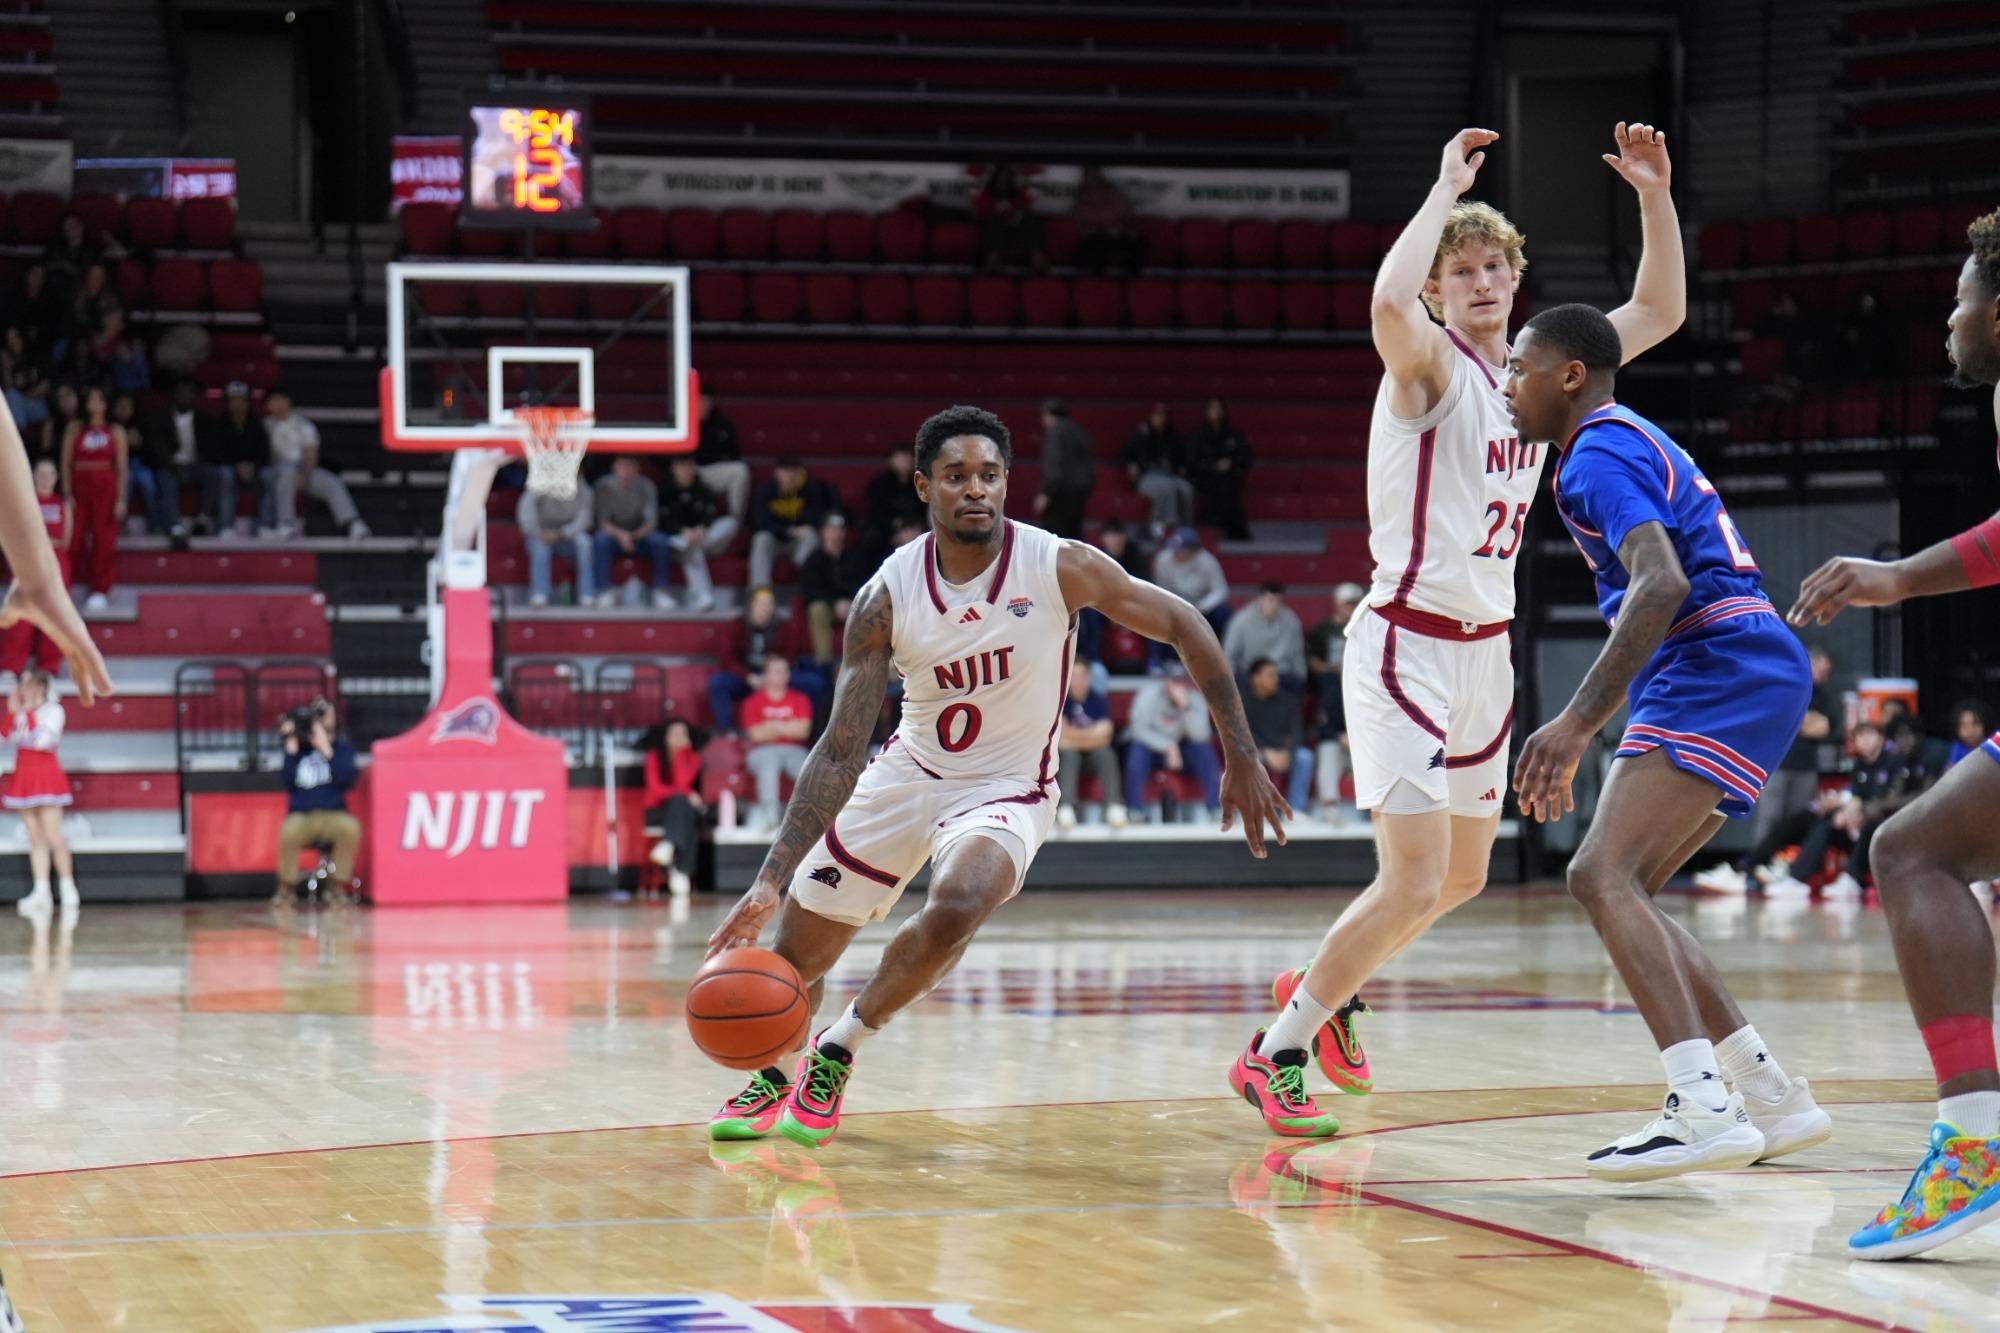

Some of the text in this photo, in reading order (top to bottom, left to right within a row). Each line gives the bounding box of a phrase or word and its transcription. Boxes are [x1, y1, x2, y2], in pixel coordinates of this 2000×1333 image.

[501, 109, 574, 148] 9:54
[514, 148, 564, 212] 12
[663, 172, 753, 191] WINGSTOP
[1186, 184, 1274, 201] WINGSTOP
[1470, 500, 1528, 560] 25
[1006, 601, 1034, 611] AMERICA
[1012, 606, 1028, 614] EAST
[933, 645, 1015, 697] NJIT
[936, 702, 983, 754] 0
[400, 789, 546, 860] NJIT
